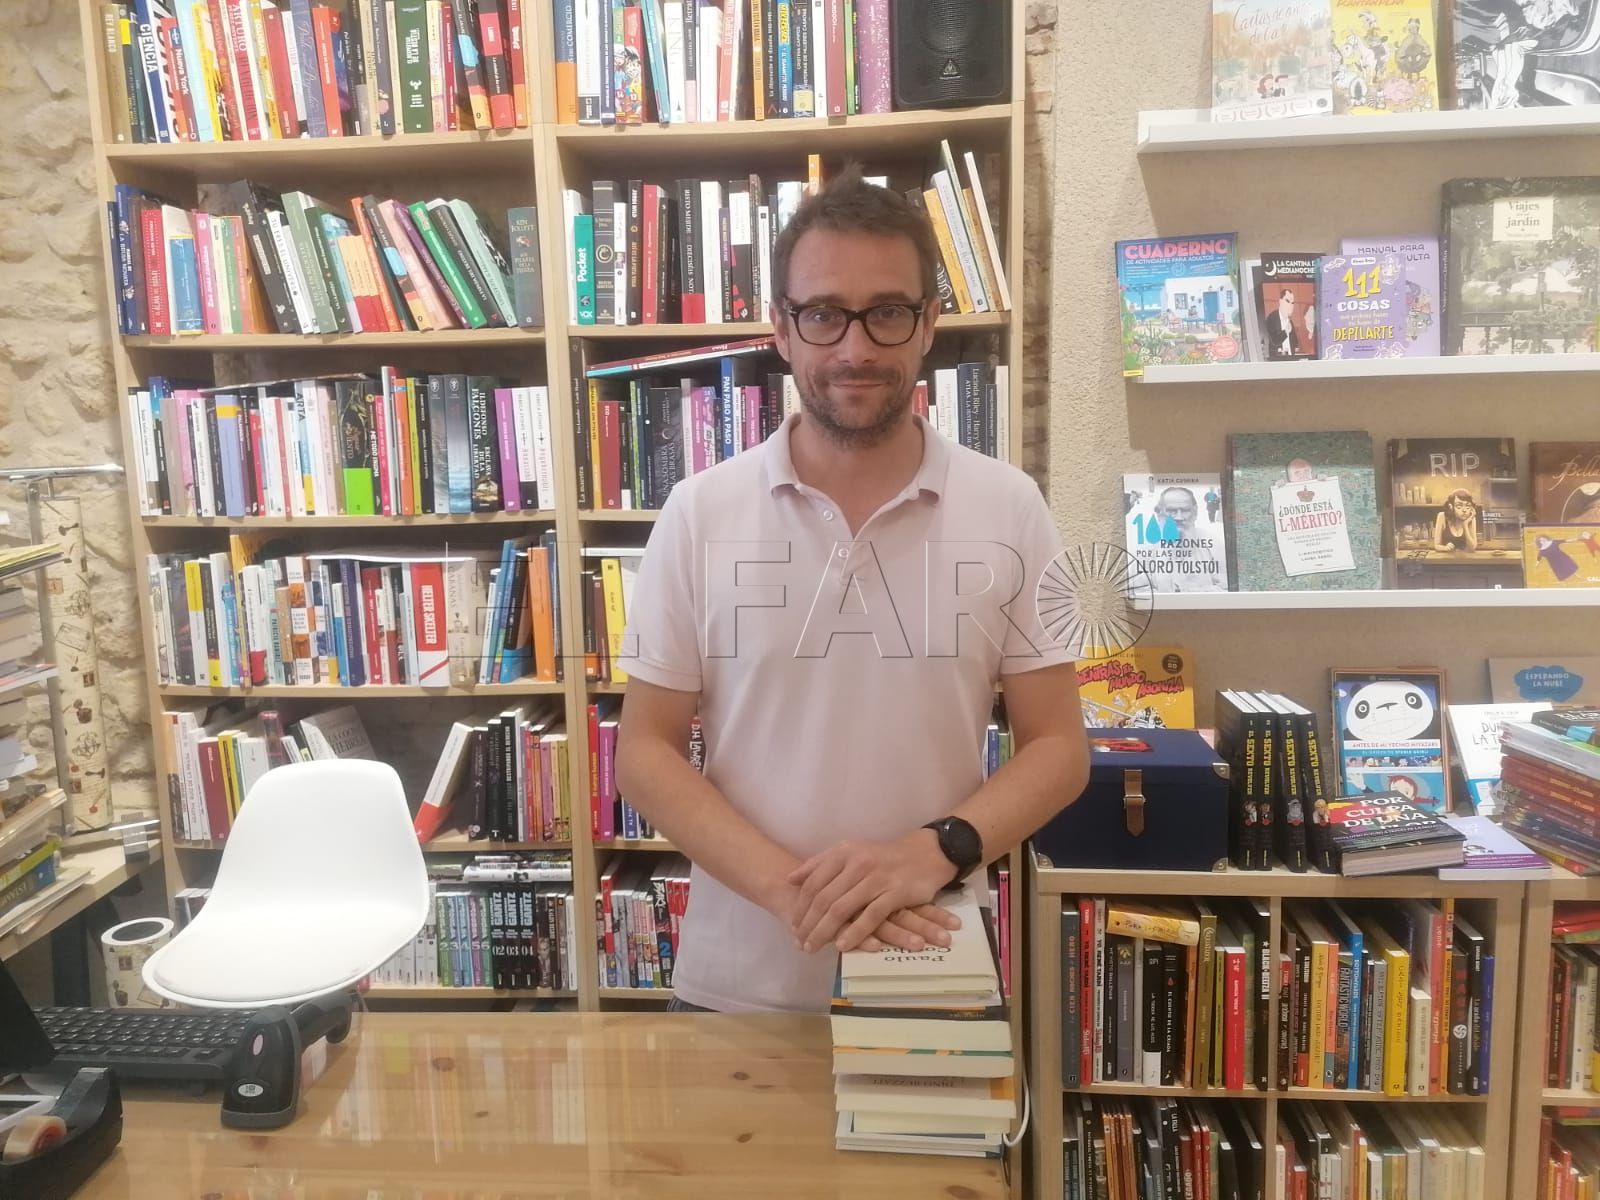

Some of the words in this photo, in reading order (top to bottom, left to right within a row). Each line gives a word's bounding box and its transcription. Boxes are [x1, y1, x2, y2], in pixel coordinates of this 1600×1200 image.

[139, 23, 157, 73] CIENCIA
[176, 49, 186, 74] Nueva
[179, 76, 188, 95] York
[1124, 239, 1231, 259] CUADERNO
[1358, 247, 1397, 255] MANUAL
[1399, 243, 1425, 251] PARA
[577, 247, 587, 283] Pocket
[1277, 266, 1315, 274] MEDIANOCHE
[1343, 266, 1382, 299] 111
[1337, 299, 1391, 312] COSAS
[1333, 325, 1394, 342] DEPILARTE
[472, 387, 481, 440] FALCONES
[479, 392, 487, 435] ILDEFONSO
[972, 398, 980, 414] Riley
[1429, 453, 1480, 477] RIP
[1279, 503, 1311, 517] ¿DÓNDE
[1313, 499, 1333, 512] ESTÁ
[1160, 539, 1213, 548] RAZONES
[1137, 558, 1174, 573] LLORÓ
[1176, 557, 1219, 574] TOLSTÓI
[421, 585, 435, 613] HELTER
[423, 613, 437, 644] SKELTER
[1246, 738, 1255, 767] SEXTO
[1263, 738, 1272, 767] SEXTO
[1286, 738, 1296, 767] SEXTO
[1308, 738, 1319, 767] SEXTO
[1346, 804, 1416, 817] CULPA
[1360, 796, 1406, 806] POR
[1343, 818, 1374, 827] DE
[1379, 812, 1428, 824] UNA
[493, 892, 503, 926] GANTZ
[508, 892, 517, 926] GANTZ
[523, 892, 532, 926] GANTZ
[660, 942, 671, 957] 2
[883, 955, 945, 963] Paulo
[1340, 967, 1351, 1004] FANTASTIC
[1338, 1004, 1349, 1034] WORLD
